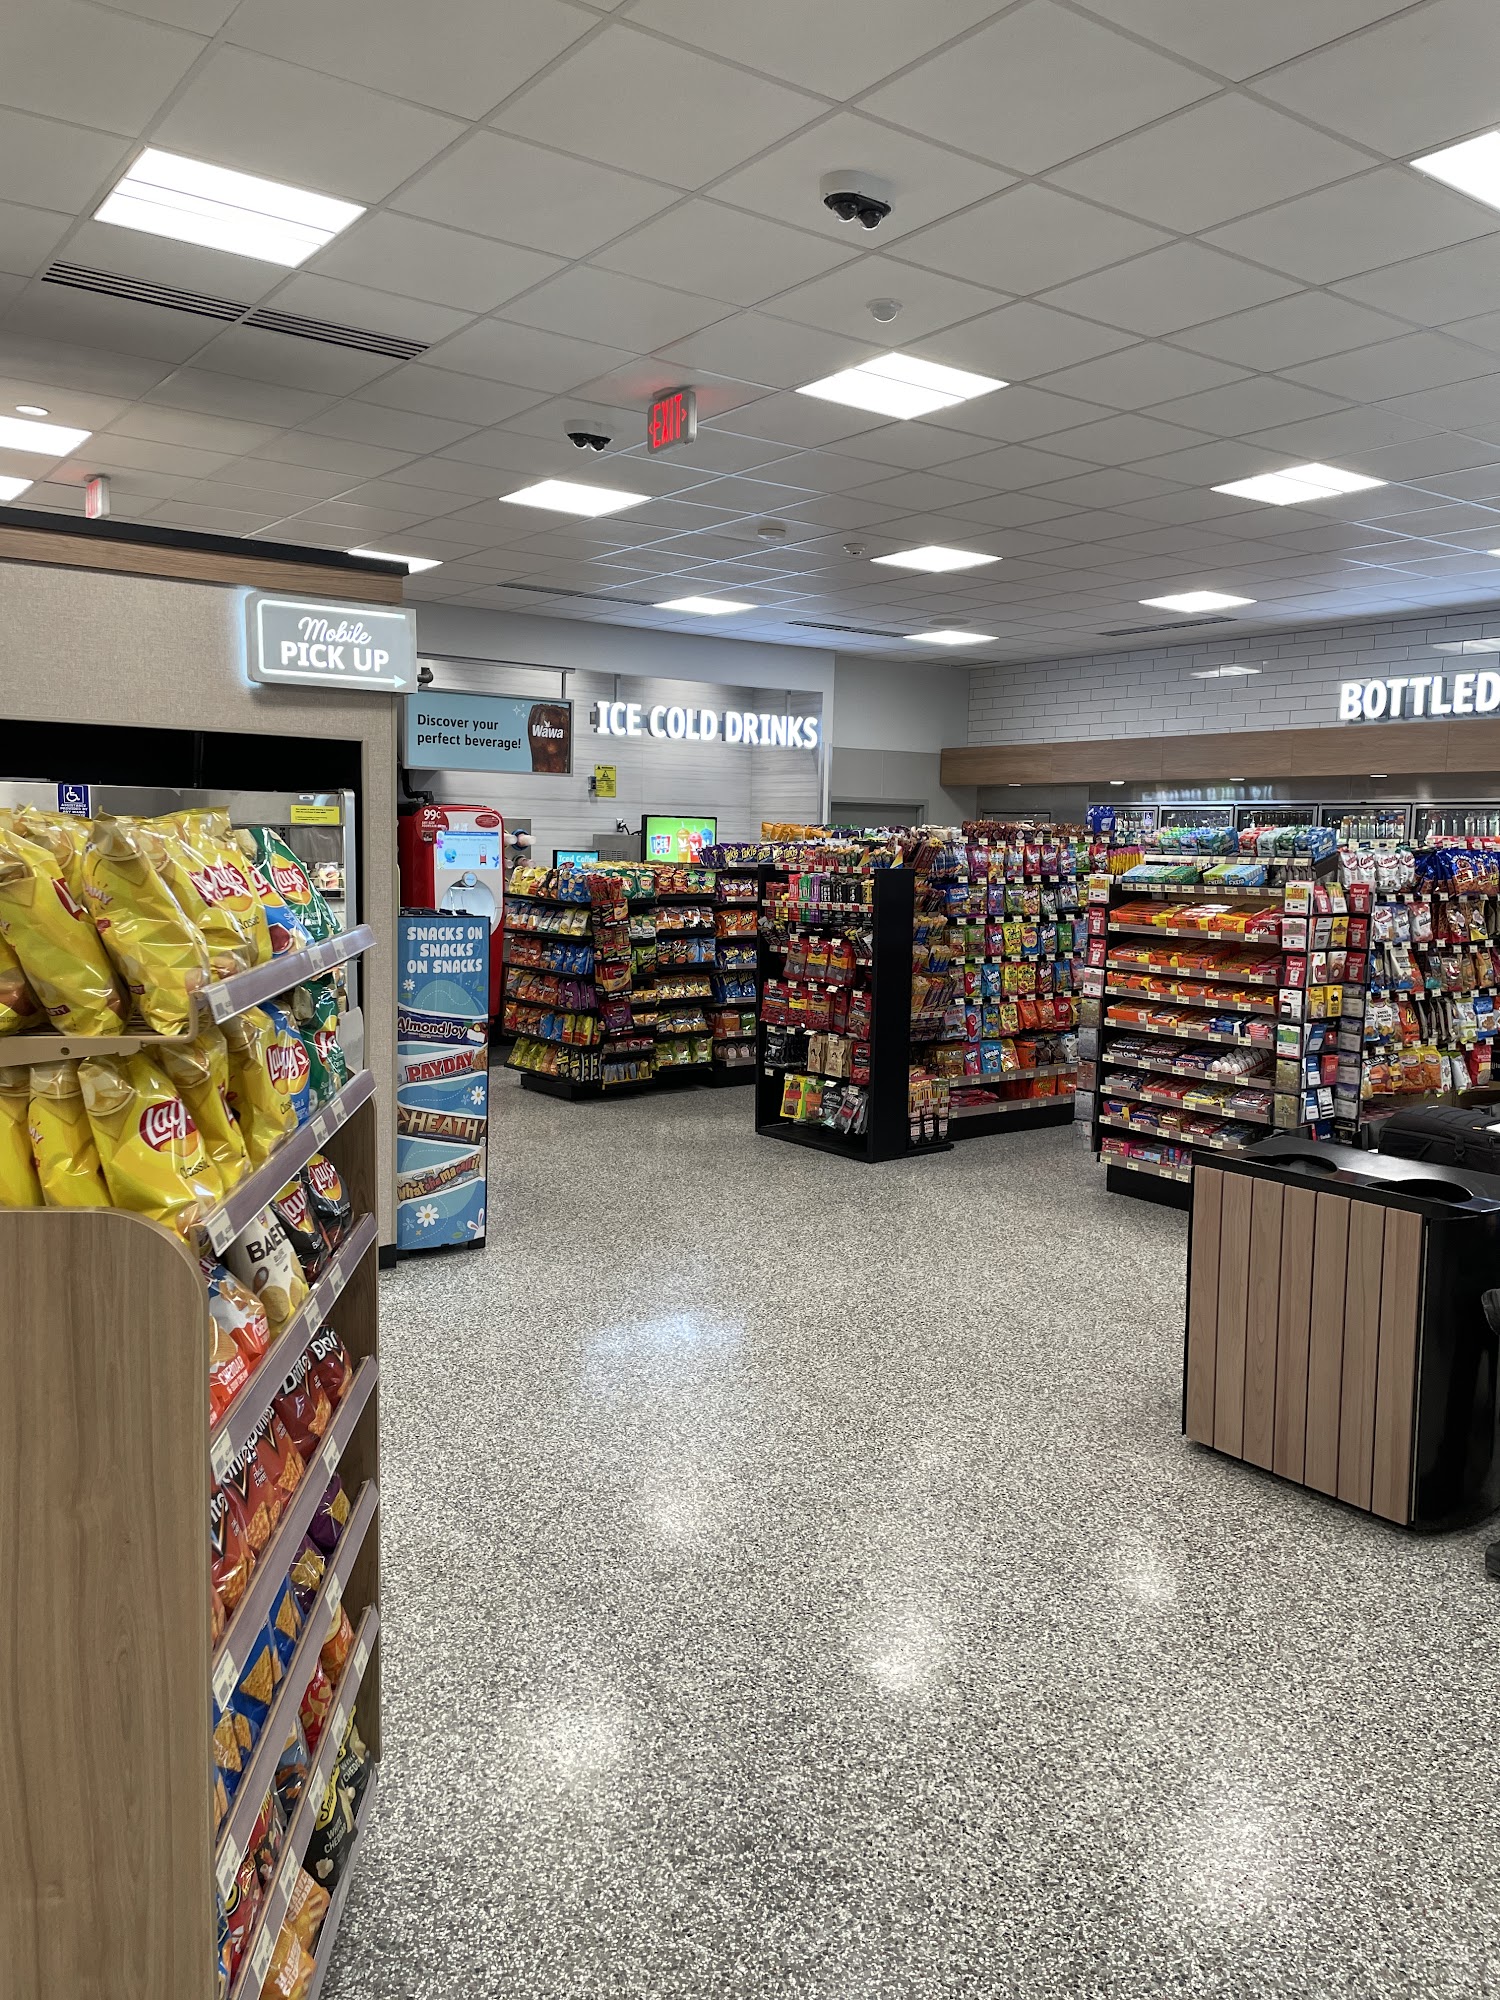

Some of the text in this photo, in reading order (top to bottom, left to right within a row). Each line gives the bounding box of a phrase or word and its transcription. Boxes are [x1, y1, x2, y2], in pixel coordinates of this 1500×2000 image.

[653, 393, 683, 449] EXIT
[298, 616, 372, 645] Mobile
[280, 640, 389, 672] PICK UP
[1340, 671, 1500, 720] BOTTLED
[417, 714, 499, 732] Discover your
[532, 724, 564, 739] Wawa
[596, 700, 819, 750] ICE COLD DRINKS
[417, 734, 522, 751] perfect beverage!
[423, 809, 441, 820] 99¢
[558, 854, 598, 863] Iced Coffee
[407, 926, 483, 941] SNACKS ON
[420, 943, 474, 957] SNACKS
[407, 958, 483, 974] ON SNACKS
[406, 1050, 474, 1083] PAYDAY
[144, 1099, 188, 1146] Lay
[407, 1111, 478, 1142] HEATH
[397, 1153, 480, 1200] Whatchamacallit
[342, 1760, 362, 1783] CHEDD
